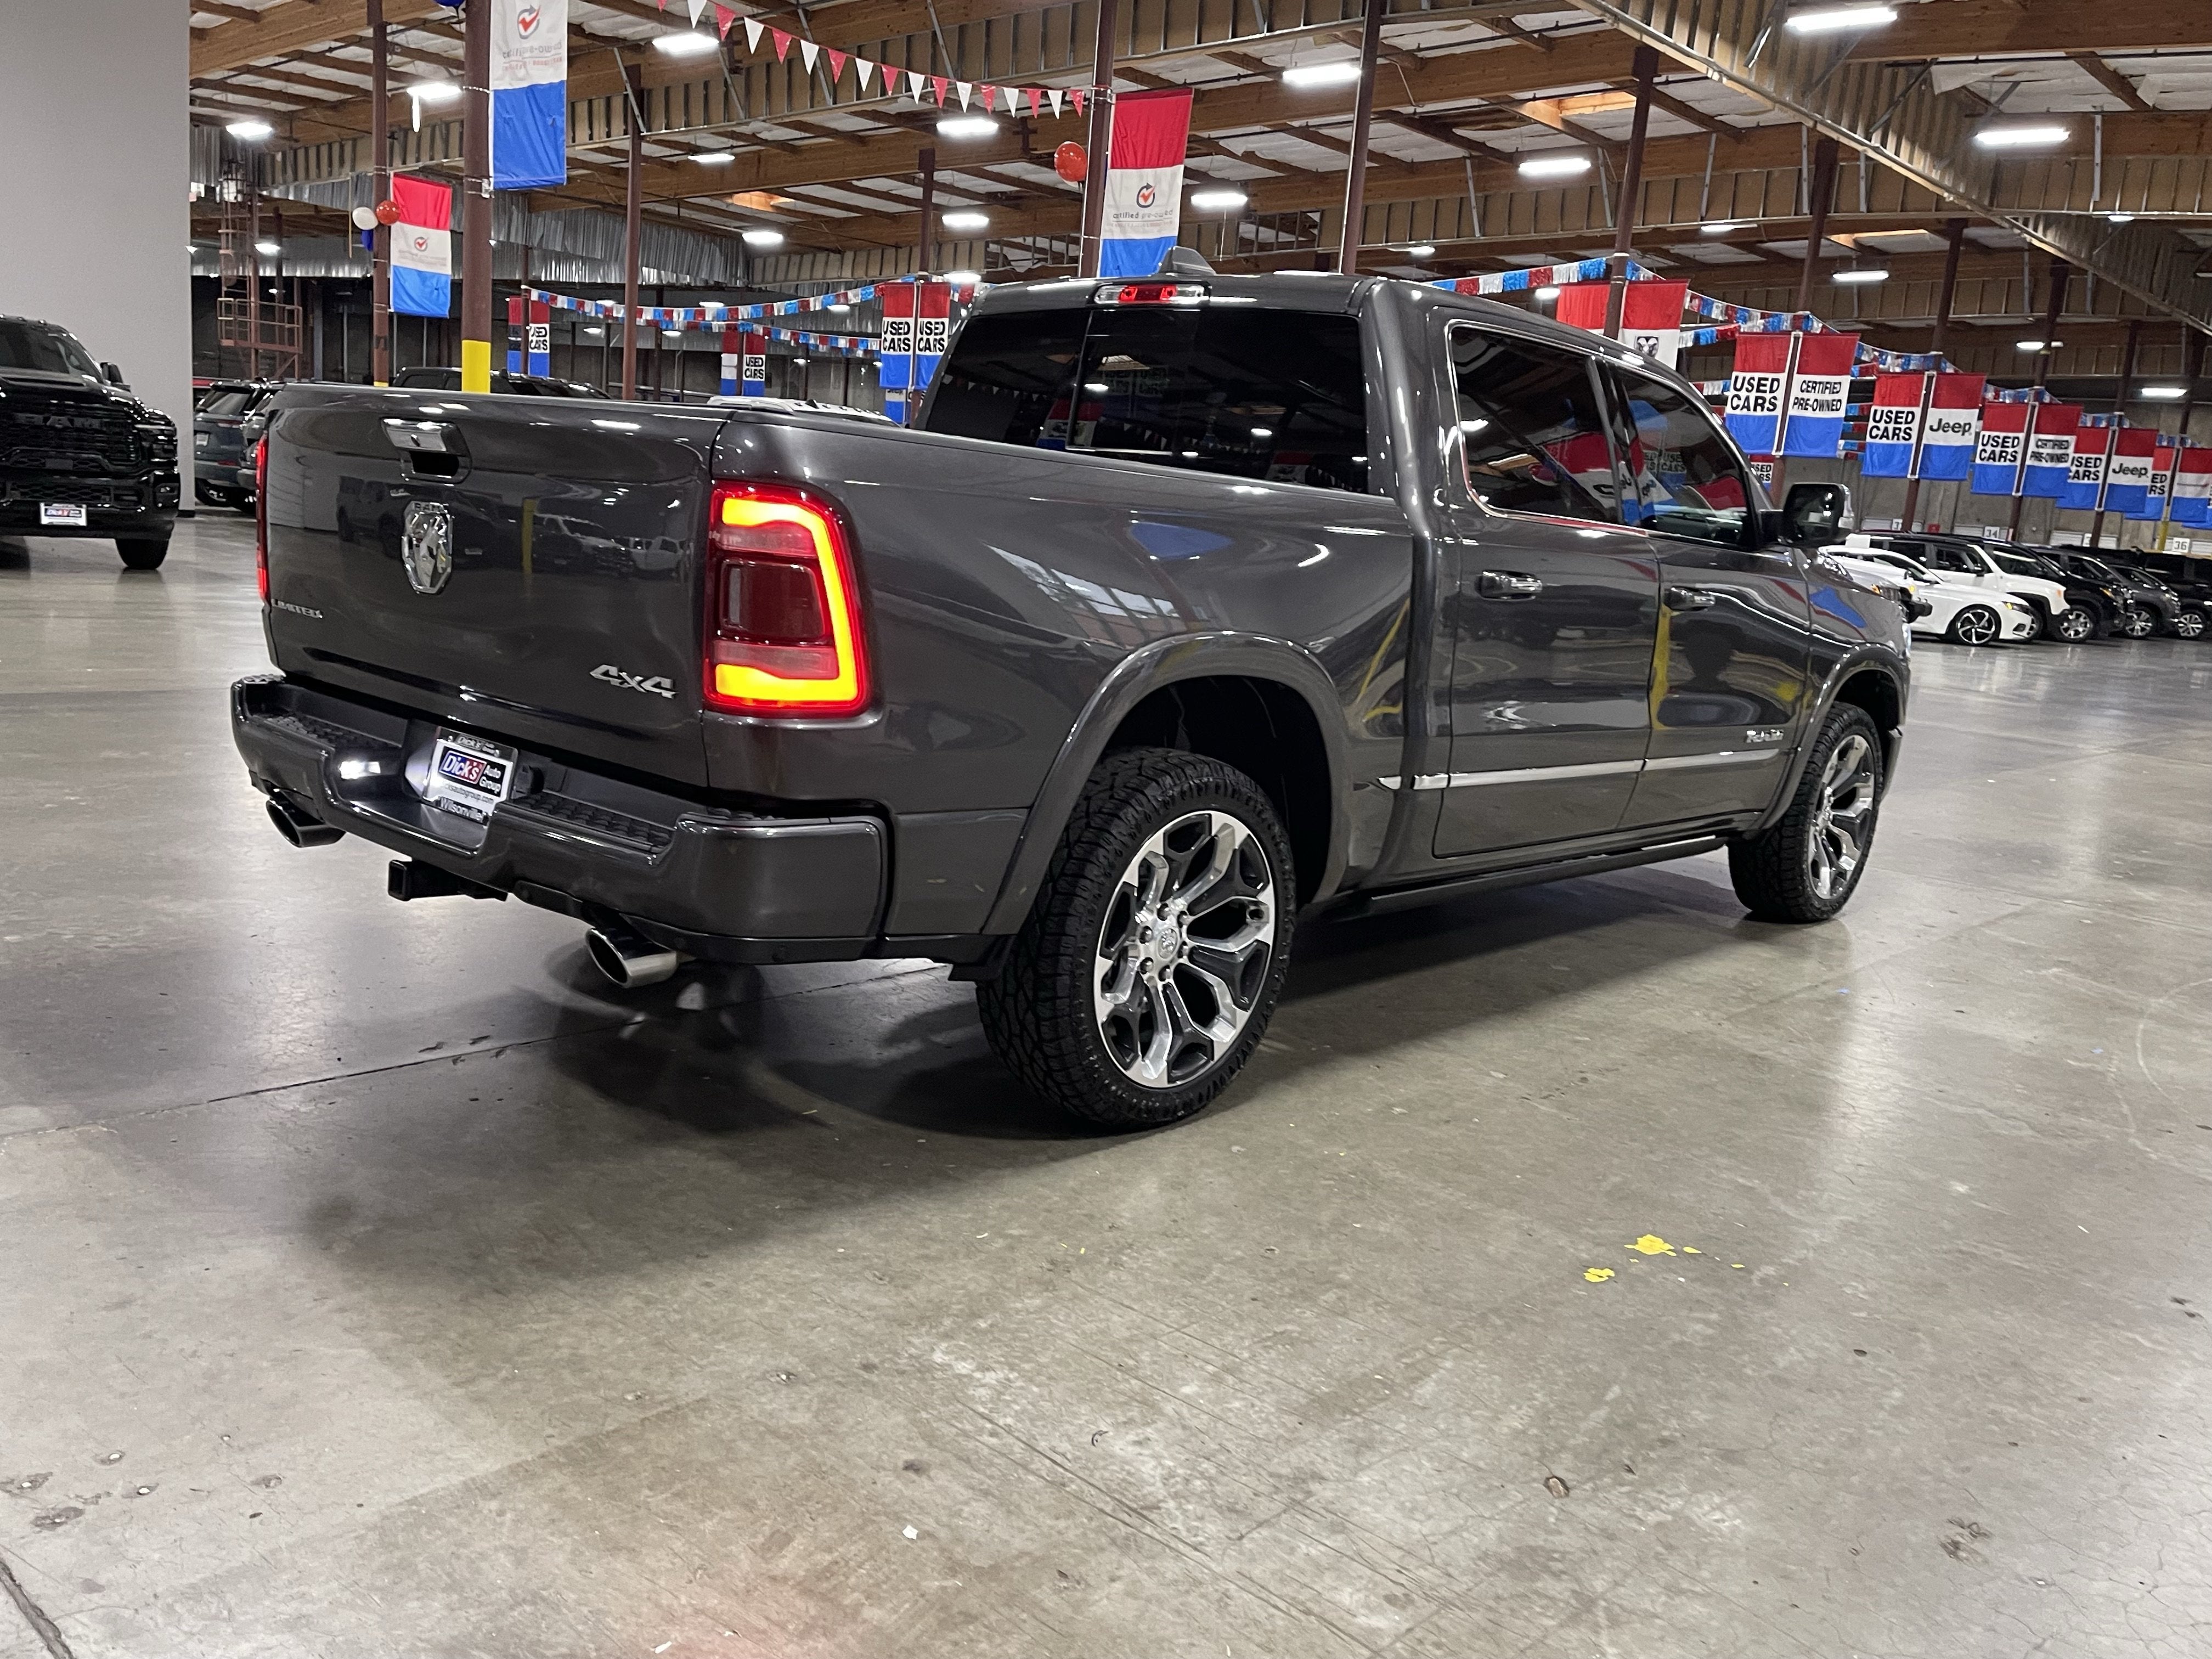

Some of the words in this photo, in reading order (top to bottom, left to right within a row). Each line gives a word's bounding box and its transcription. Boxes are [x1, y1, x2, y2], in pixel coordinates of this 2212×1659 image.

[883, 320, 911, 336] USED
[919, 320, 945, 336] USED
[883, 337, 911, 352] CARS
[918, 337, 945, 353] CARS
[1733, 375, 1780, 393] USED
[1800, 380, 1842, 394] CERTIFIED
[1730, 394, 1778, 411] CARS
[1792, 396, 1842, 412] PRE-OWNED
[1872, 409, 1915, 425] USED
[1869, 425, 1913, 441] CARS
[1929, 418, 1972, 436] Jeep
[1981, 434, 2020, 449] USED
[1979, 448, 2018, 462] CARS
[1751, 464, 1771, 472] SED
[2069, 470, 2100, 481] ARS
[2112, 463, 2148, 478] Jeep
[1759, 473, 1771, 481] RS
[2151, 473, 2168, 484] ED
[2148, 485, 2165, 495] RS
[1986, 529, 1998, 538] 34
[2174, 540, 2187, 550] 36
[483, 765, 501, 779] Auto
[479, 776, 501, 794] Group
